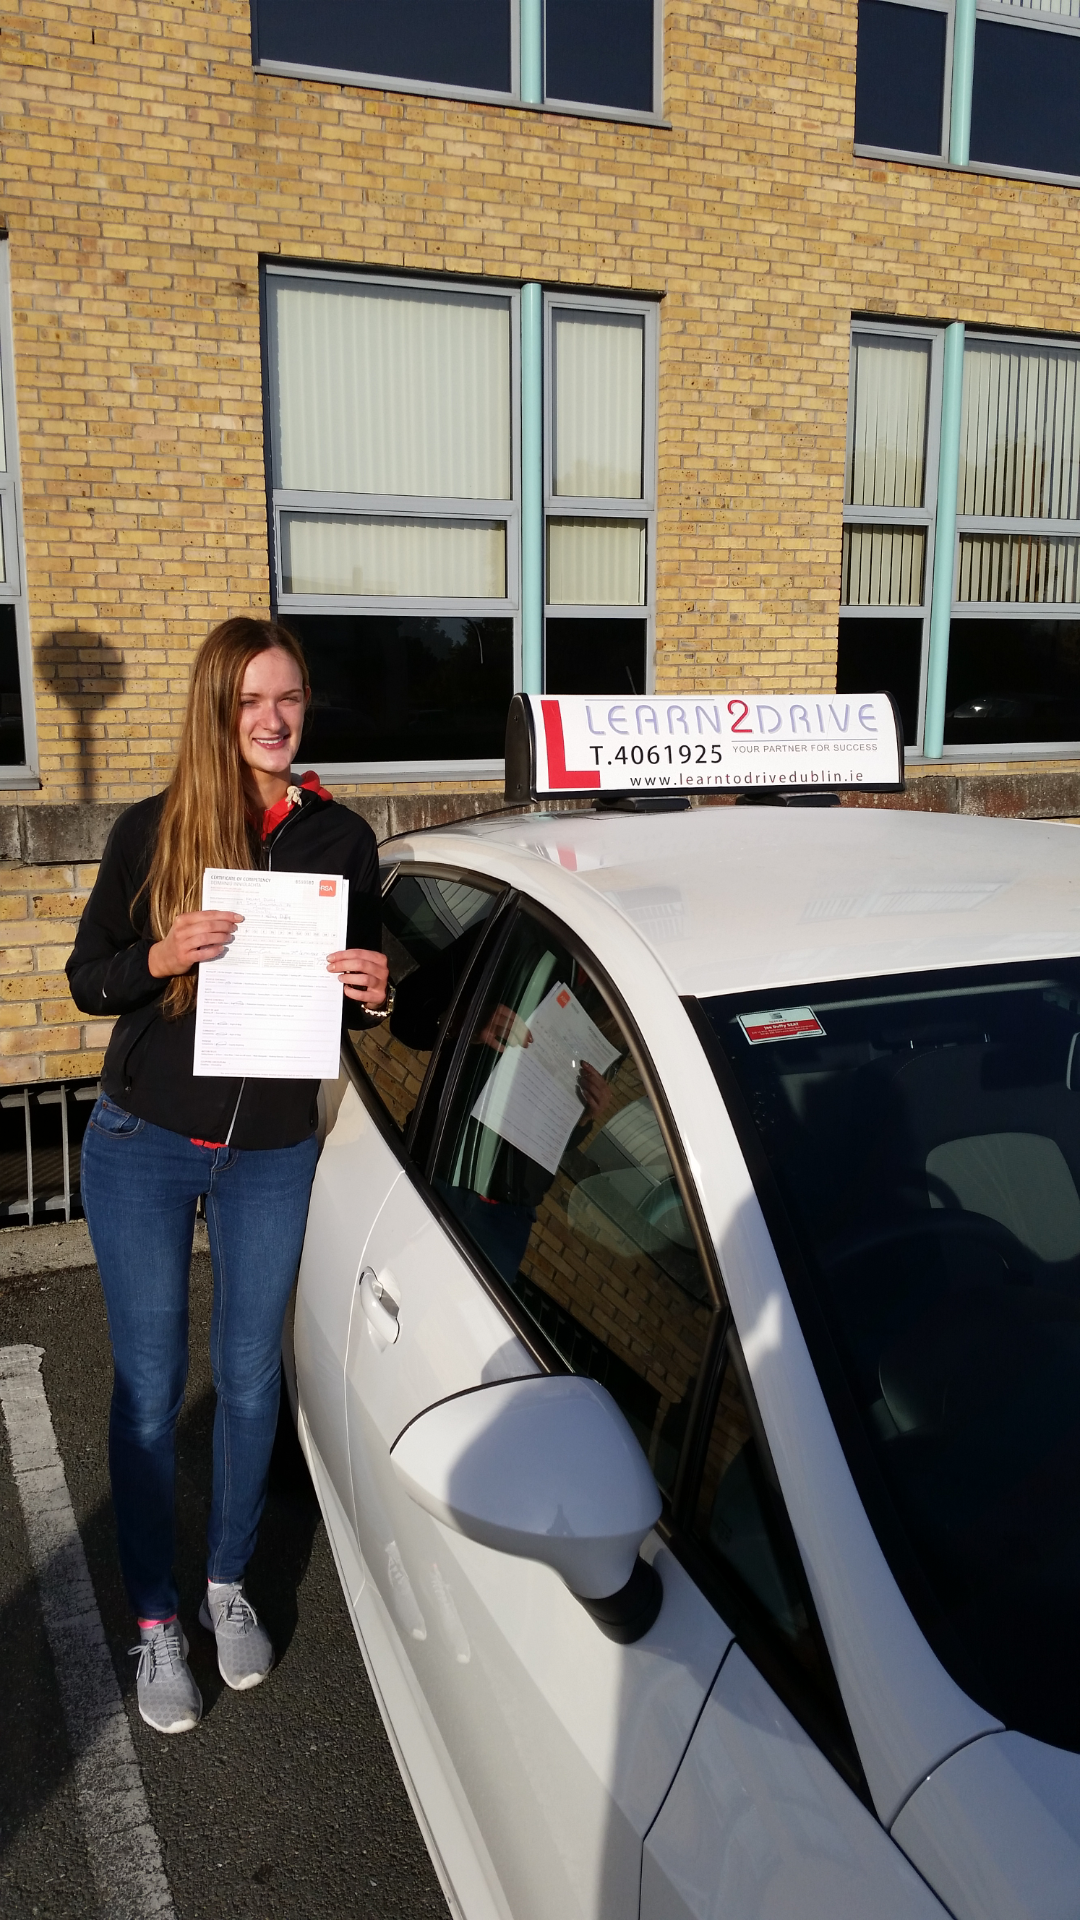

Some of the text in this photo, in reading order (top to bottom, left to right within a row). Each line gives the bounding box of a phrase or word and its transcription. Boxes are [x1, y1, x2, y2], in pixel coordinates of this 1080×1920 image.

[540, 700, 601, 789] L
[589, 743, 723, 766] T.4061925
[732, 743, 878, 753] YOUR PARTNER FOR SUCCESS
[630, 770, 864, 787] www.learntodrivedublin.ie
